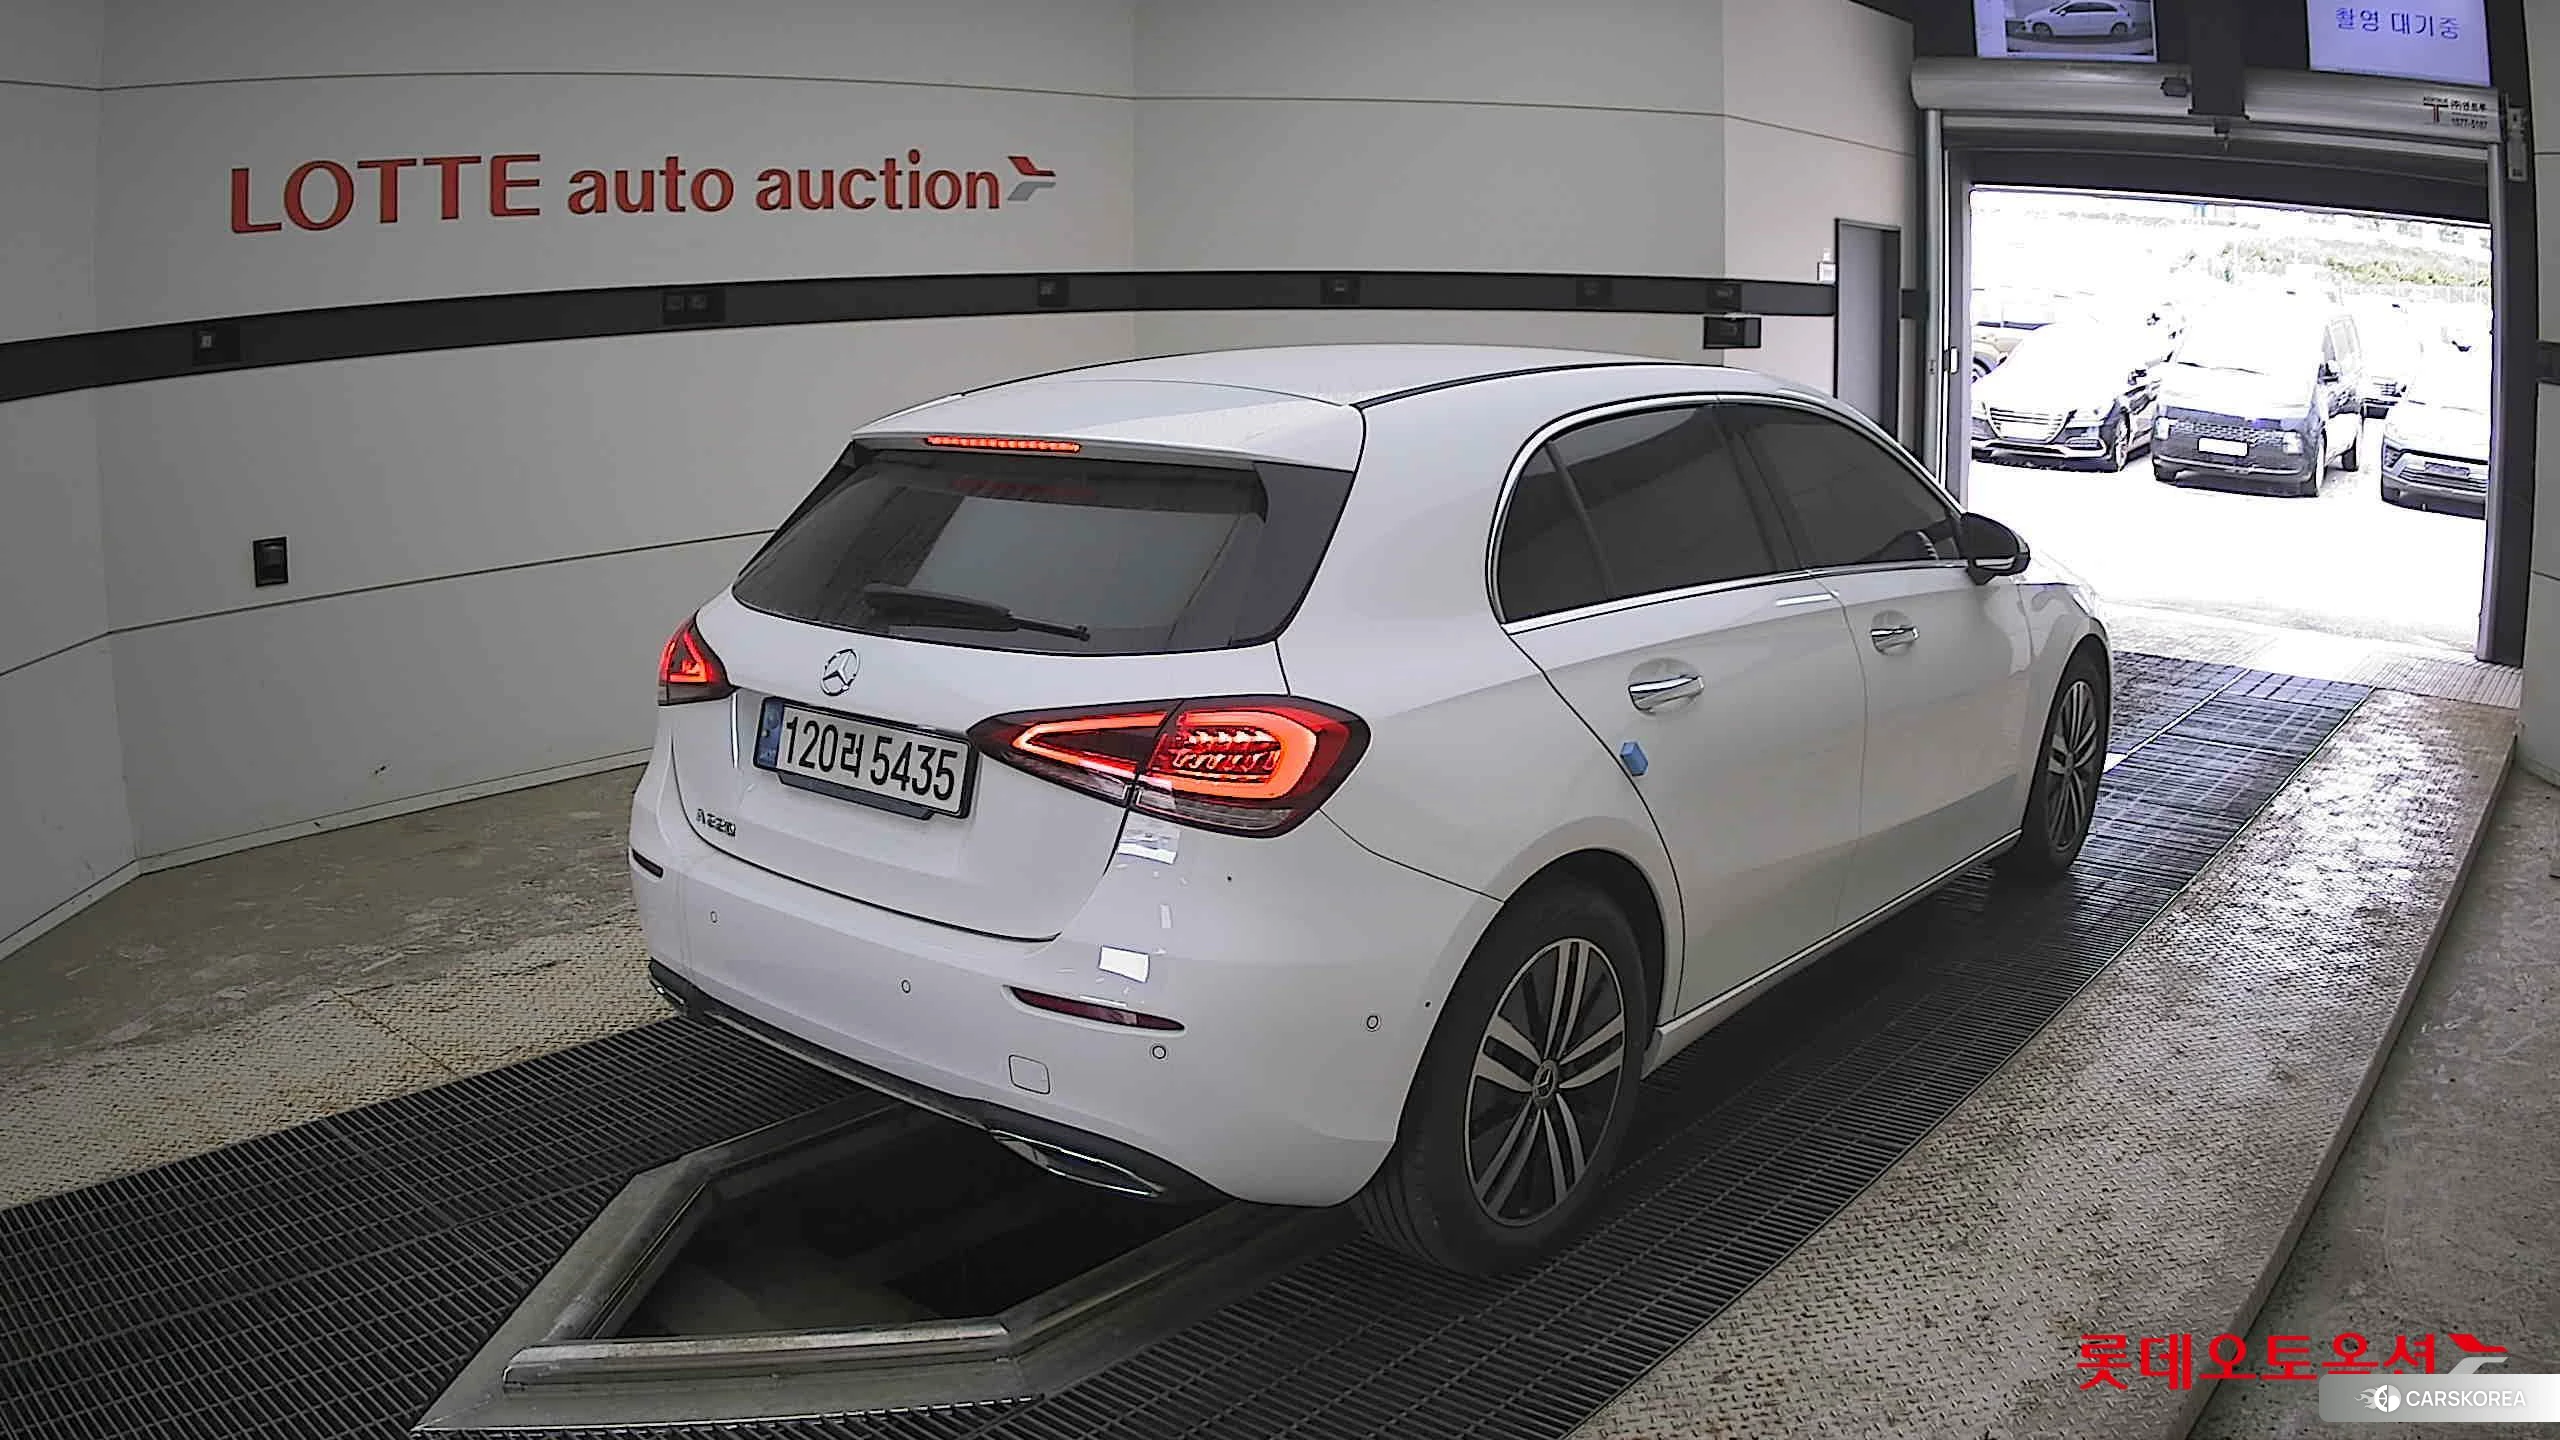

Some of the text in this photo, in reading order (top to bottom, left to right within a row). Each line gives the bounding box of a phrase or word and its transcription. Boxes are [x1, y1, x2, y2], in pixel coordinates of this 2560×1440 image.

[2391, 12, 2460, 40] 대기중
[231, 149, 1002, 233] LOTTE auto auction
[870, 736, 958, 801] 5435
